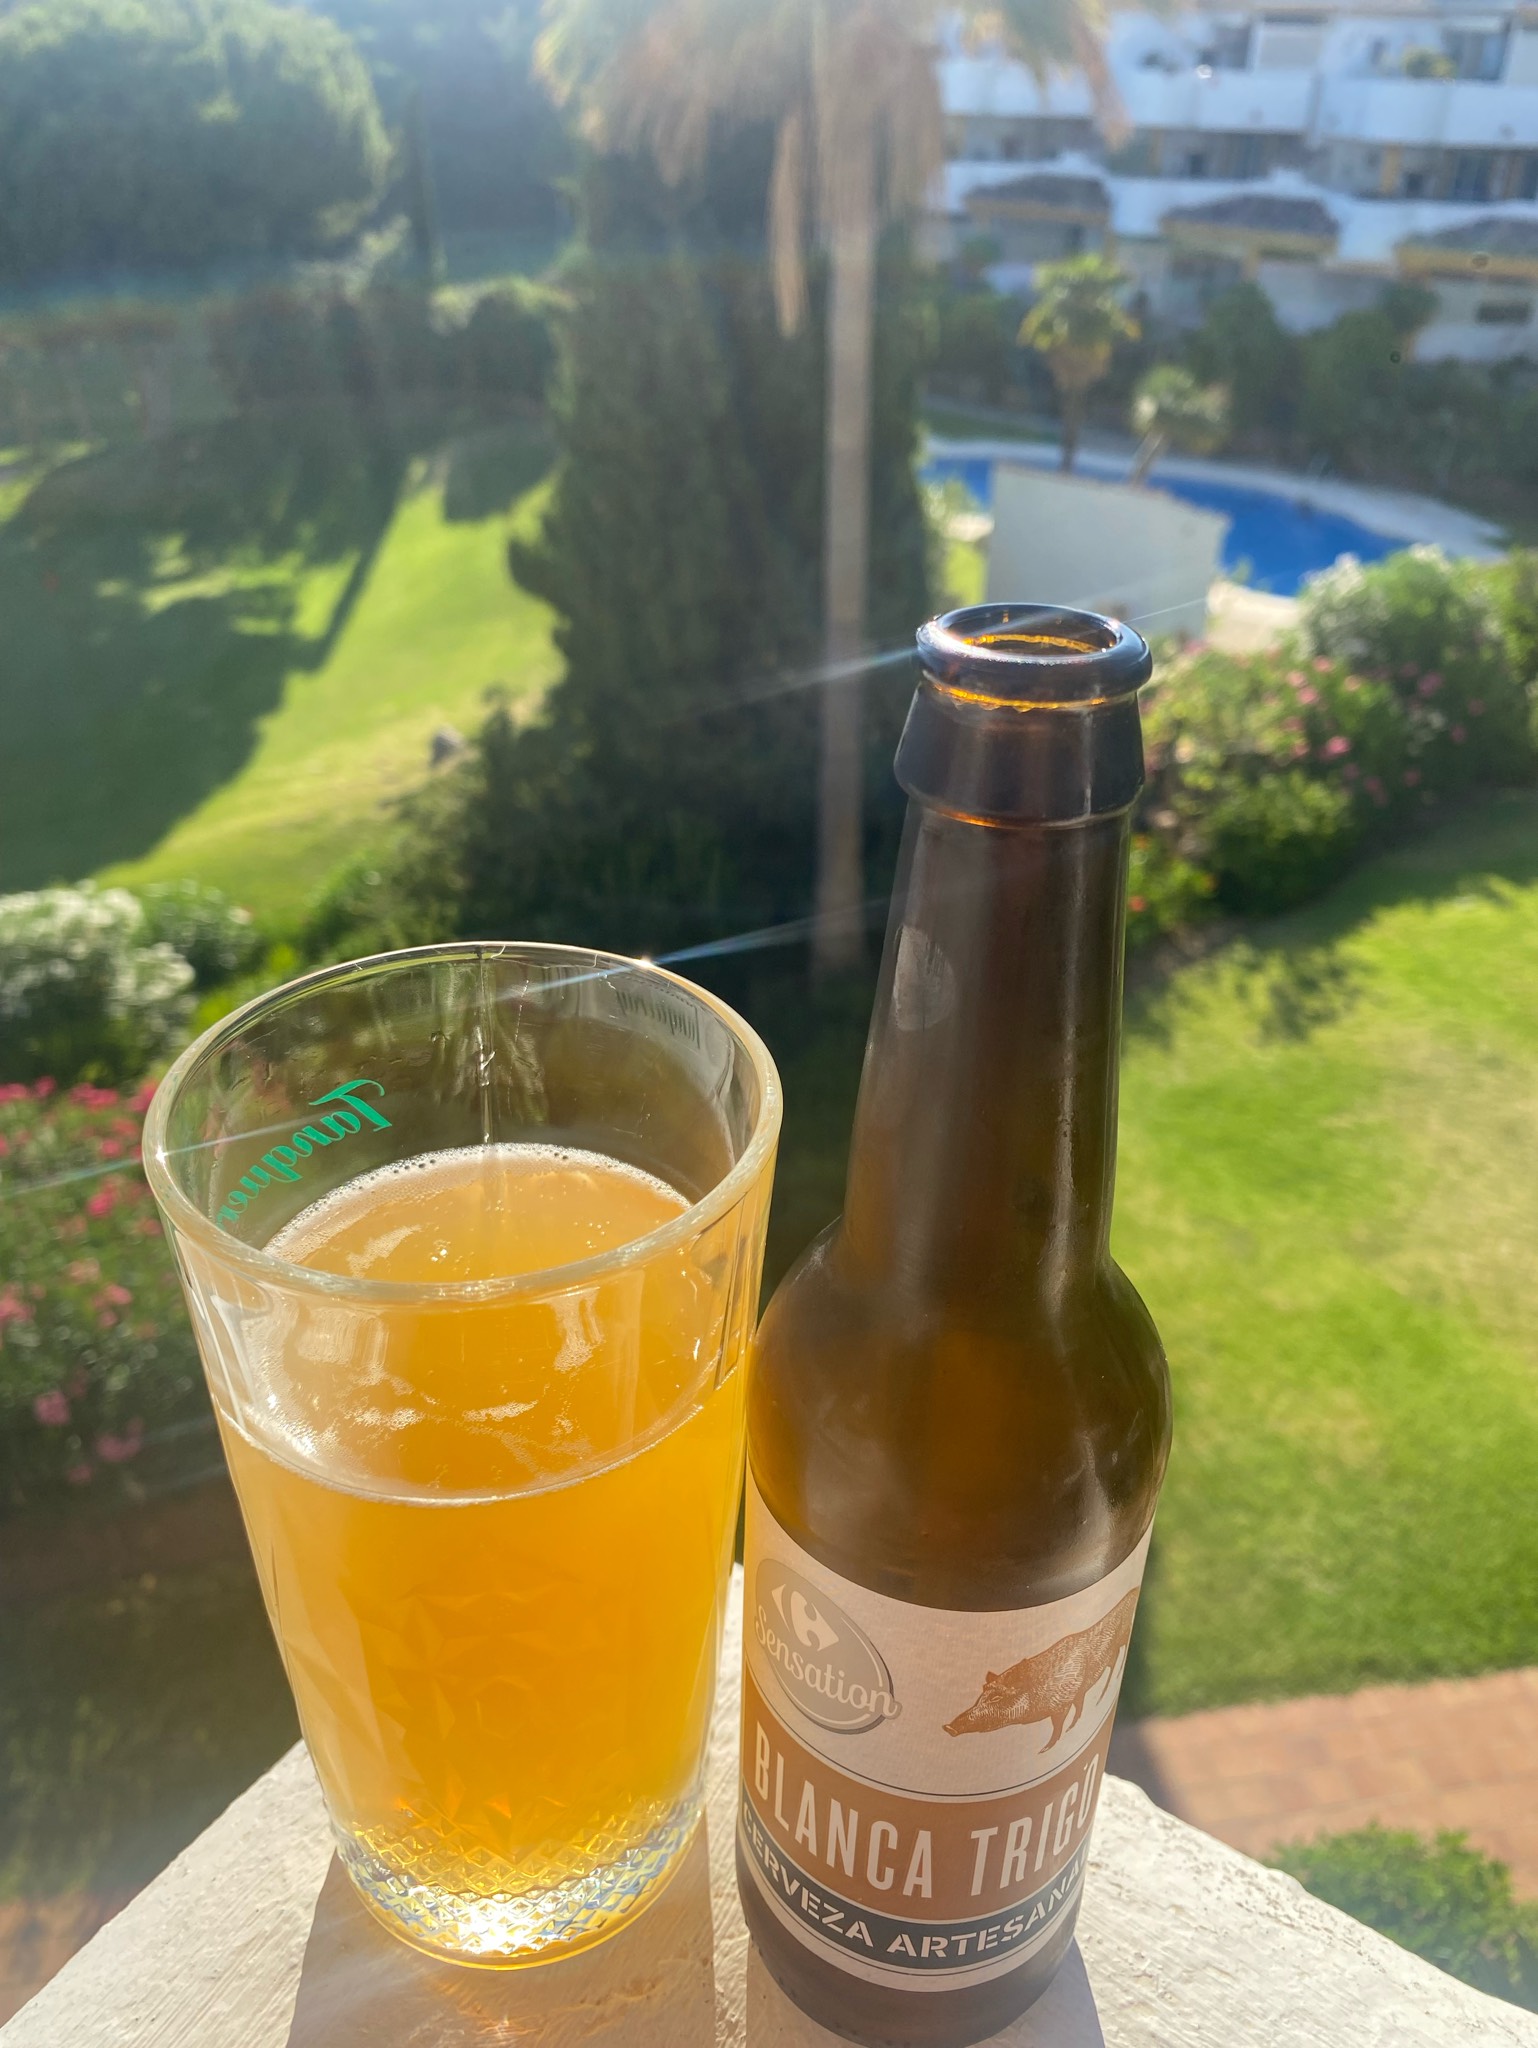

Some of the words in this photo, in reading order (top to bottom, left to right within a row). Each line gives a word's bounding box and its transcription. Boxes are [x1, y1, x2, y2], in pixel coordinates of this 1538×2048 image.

[755, 1604, 899, 1718] Sensation
[743, 1801, 874, 1948] CERVEZA
[755, 1720, 932, 1899] BLANCA
[970, 1753, 1099, 1896] TRIGO
